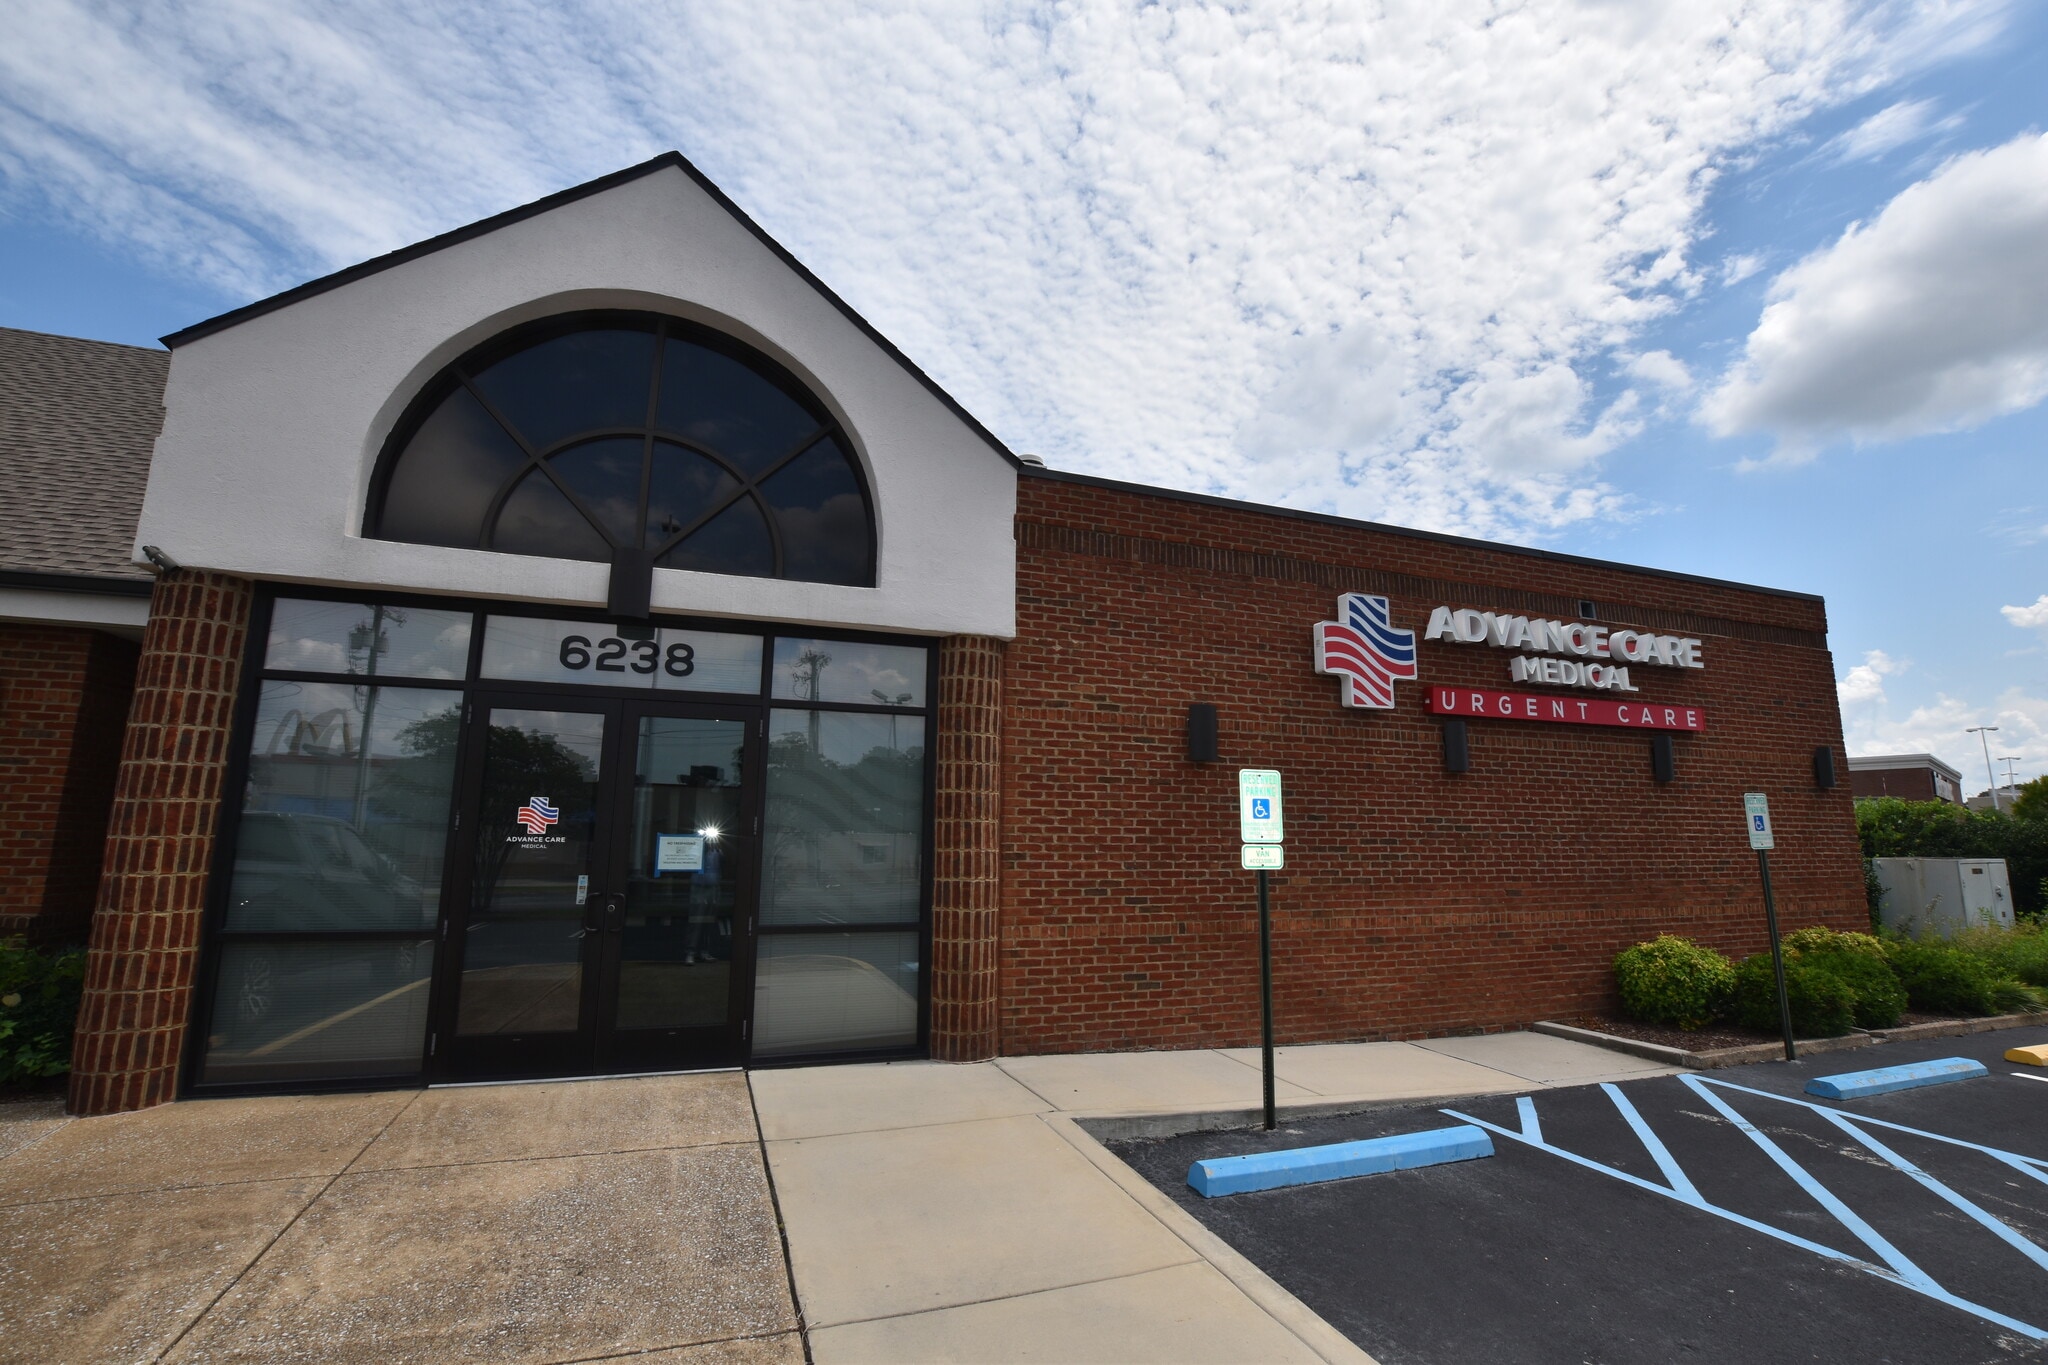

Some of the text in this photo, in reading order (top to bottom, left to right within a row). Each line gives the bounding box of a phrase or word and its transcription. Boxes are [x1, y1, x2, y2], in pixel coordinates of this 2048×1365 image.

[559, 635, 695, 677] 6238
[1424, 605, 1705, 669] ADVANCE CARE
[1510, 654, 1640, 692] MEDICAL
[1441, 690, 1698, 728] URGENT CARE
